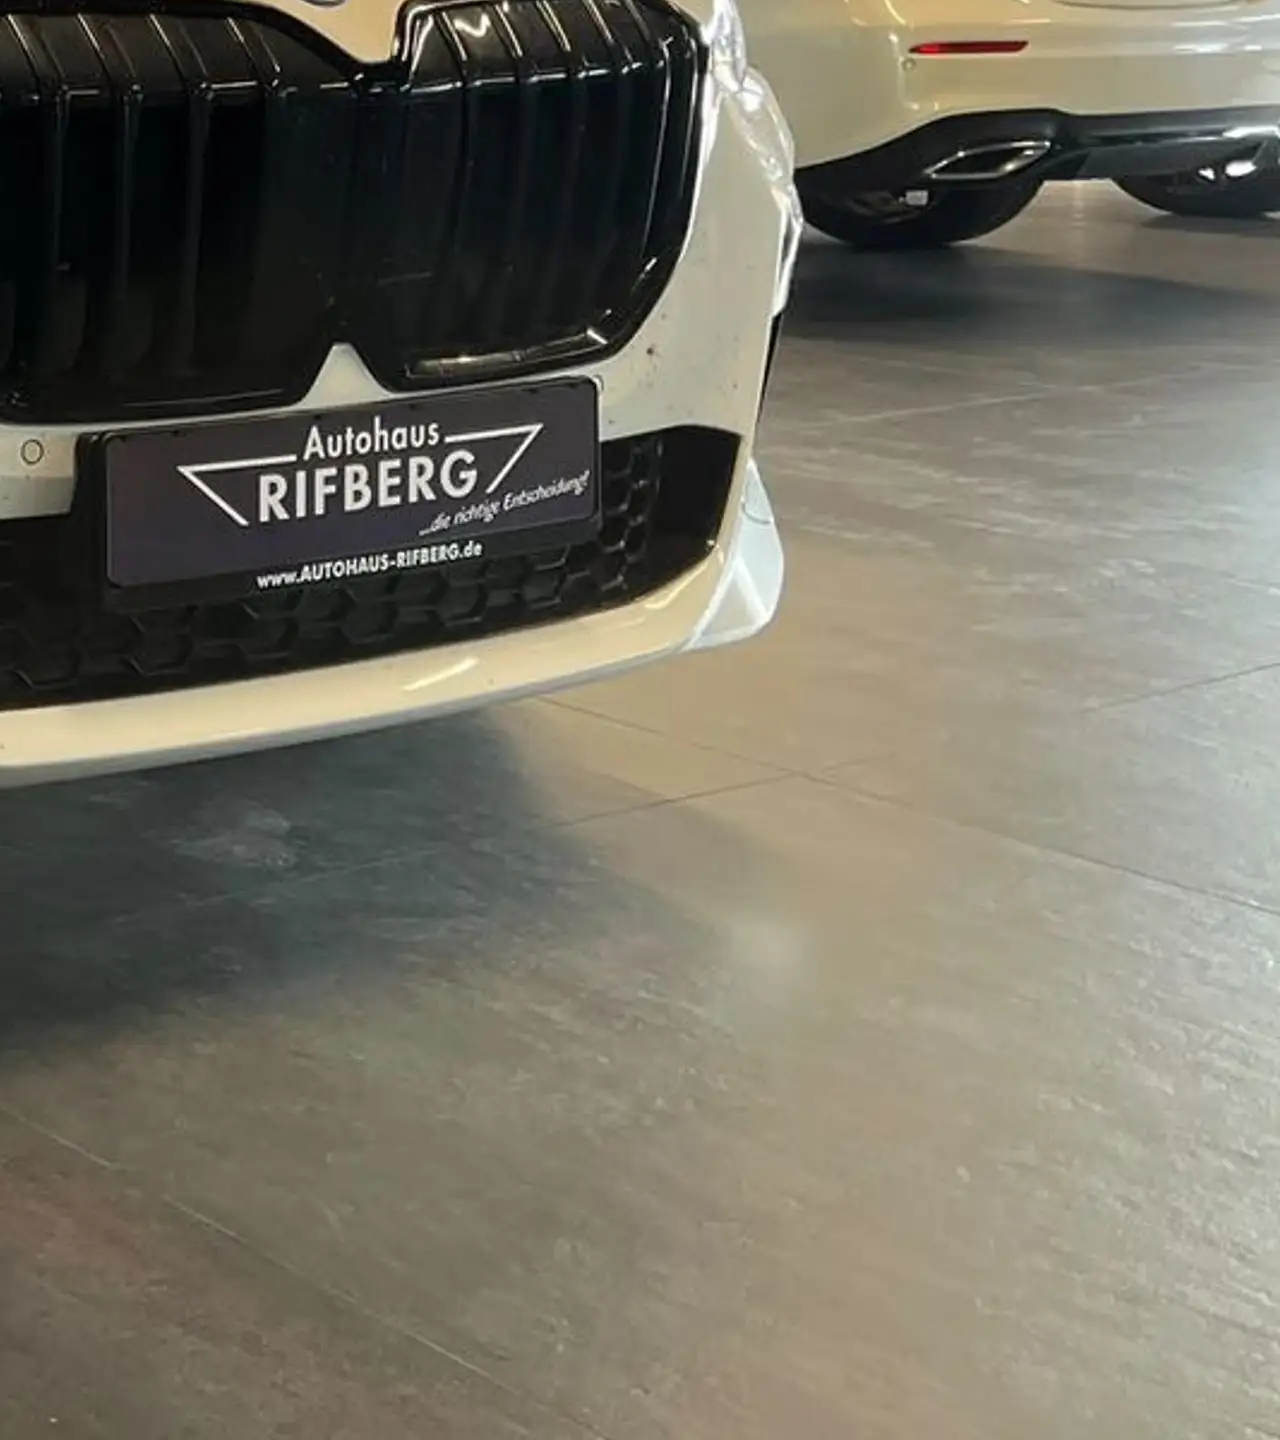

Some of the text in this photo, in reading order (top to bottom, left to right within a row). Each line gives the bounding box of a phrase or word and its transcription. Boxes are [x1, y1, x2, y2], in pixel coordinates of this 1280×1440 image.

[303, 415, 440, 461] Autohaus
[258, 449, 478, 523] RIFBERG
[453, 498, 501, 523] richtige
[256, 540, 483, 589] www.AUTOHAUS-RIFBERG.de
